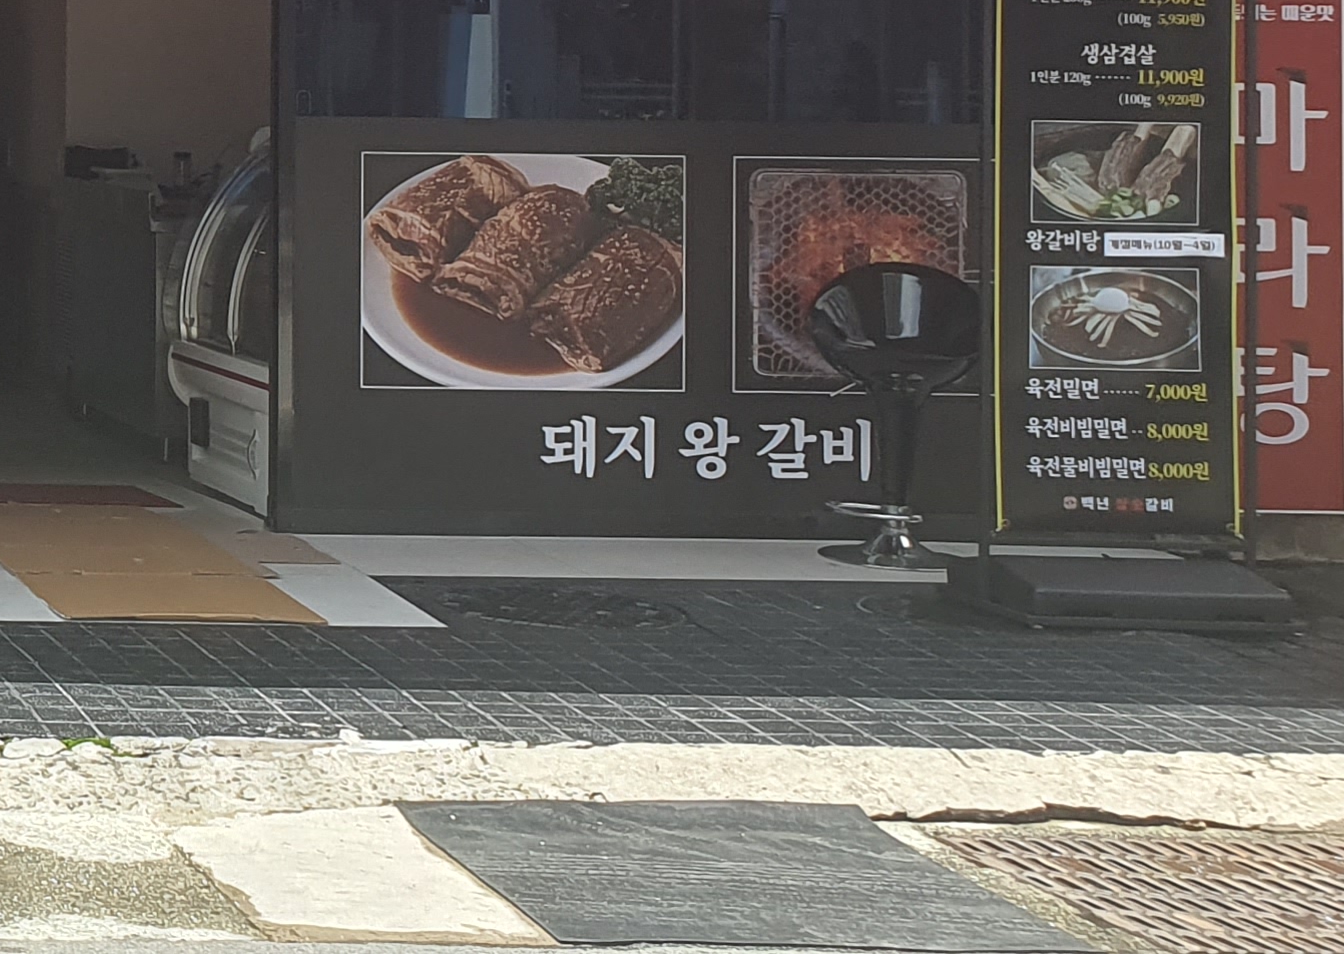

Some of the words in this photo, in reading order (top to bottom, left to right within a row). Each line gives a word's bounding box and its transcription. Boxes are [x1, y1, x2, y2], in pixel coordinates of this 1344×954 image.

[1117, 12, 1151, 27] (100g
[1281, 3, 1335, 23] 매운맛
[1080, 43, 1157, 66] 생삼겹살
[1030, 70, 1061, 84] 1인분
[1063, 71, 1091, 87] 120g
[1137, 69, 1205, 88] 11,900원
[1118, 92, 1152, 107] (100g
[1025, 229, 1101, 252] 왕갈비탕
[1025, 377, 1100, 400] 육전밀면
[1145, 382, 1209, 403] 7,000원
[1025, 416, 1129, 440] 육전비빔밀면
[1146, 422, 1210, 442] 8,000원
[540, 415, 656, 479] 돼지
[678, 416, 740, 480] 왕
[756, 417, 872, 482] 갈비
[1026, 456, 1147, 479] 육전물비빔밀면
[1148, 461, 1211, 481] 8,000원
